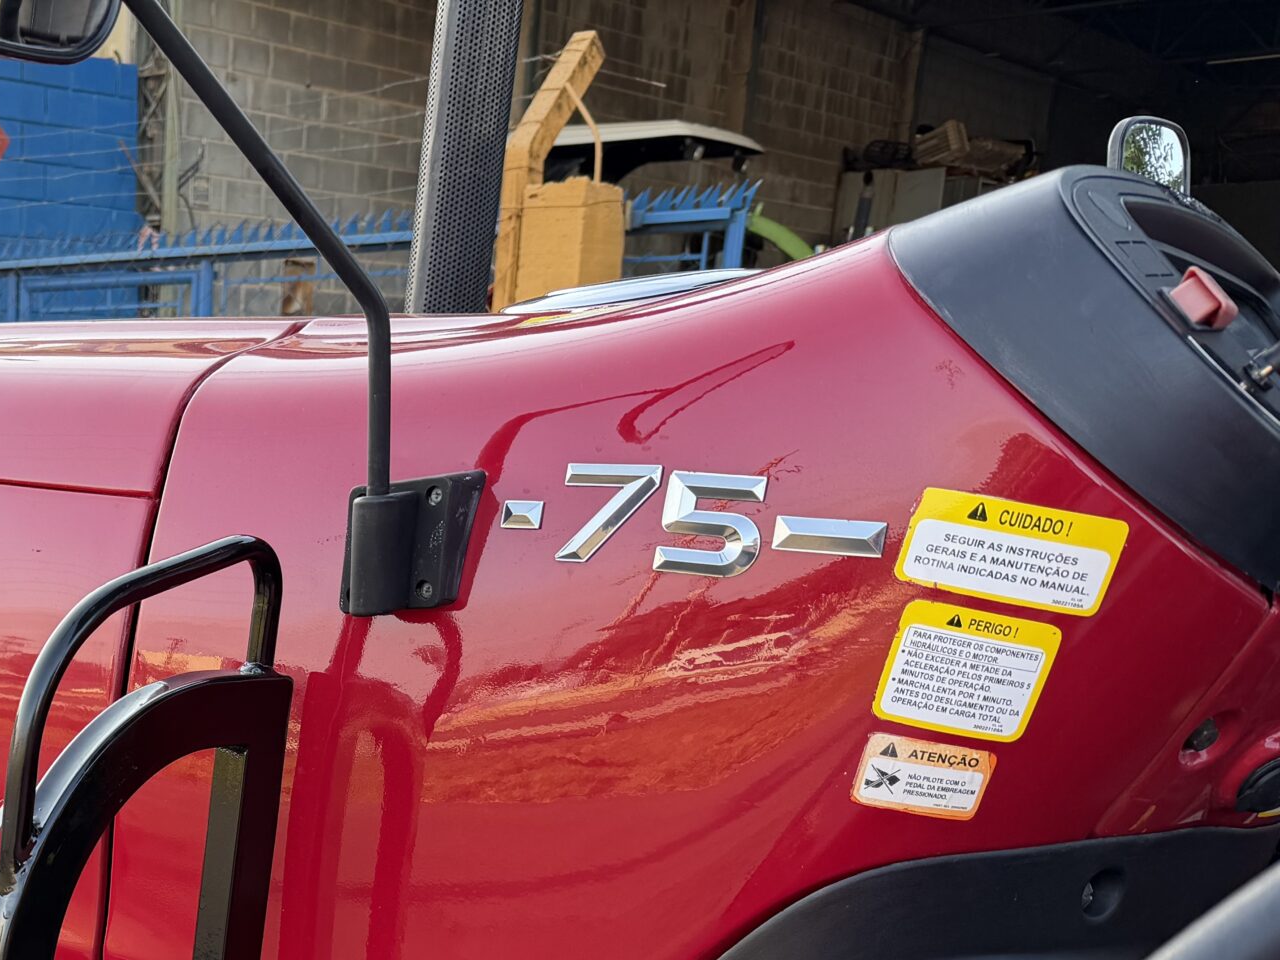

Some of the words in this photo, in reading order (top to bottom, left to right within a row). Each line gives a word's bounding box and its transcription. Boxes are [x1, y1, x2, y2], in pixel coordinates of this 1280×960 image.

[999, 509, 1064, 535] CUIDADO
[926, 544, 967, 559] GERAIS
[969, 552, 978, 562] E
[978, 554, 987, 563] A
[989, 556, 1070, 579] MANUTENÇÃO
[1072, 571, 1088, 582] DE
[944, 533, 986, 549] SEGUIR
[987, 542, 1003, 552] AS
[1005, 545, 1079, 566] INSTRUÇÕES
[914, 555, 954, 571] ROTINA
[957, 564, 1018, 583] INDICADAS
[1020, 576, 1037, 587] NO
[1040, 579, 1090, 596] MANUAL.
[968, 618, 1012, 637] PERIGO
[910, 639, 958, 656] HIDRÁULICOS
[964, 650, 971, 659] O
[912, 630, 932, 640] PARA
[933, 634, 972, 649] PROTEGER
[974, 642, 984, 652] OS
[985, 645, 1039, 662] COMPONENTES
[904, 659, 956, 676] ACELERAÇÃO
[957, 670, 982, 682] PELOS
[983, 675, 1025, 690] PRIMEIROS
[907, 649, 924, 660] NÃO
[925, 653, 961, 668] EXCEDER
[969, 662, 1000, 676] METADE
[1002, 669, 1013, 678] DA
[897, 678, 931, 692] MARCHA
[932, 684, 957, 697] LENTA
[958, 690, 976, 700] POR
[982, 695, 1013, 707] MINUTO.
[901, 668, 935, 681] MINUTOS
[936, 676, 947, 684] DE
[948, 679, 991, 694] OPERAÇÃO.
[891, 695, 935, 711] OPERAÇÃO
[936, 705, 948, 714] EM
[949, 709, 976, 720] CARGA
[978, 712, 1002, 724] TOTAL
[894, 687, 920, 699] ANTES
[921, 692, 934, 701] DO
[934, 695, 995, 713] DESLIGAMENTO
[996, 706, 1008, 716] OU
[1008, 708, 1020, 717] DA
[908, 749, 980, 768] ATENÇÃO
[902, 788, 948, 800] PRESSIONADO.
[905, 781, 926, 790] PEDAL
[936, 786, 976, 795] EMBREAGEM
[922, 776, 944, 784] PILOTE
[945, 779, 960, 787] COM
